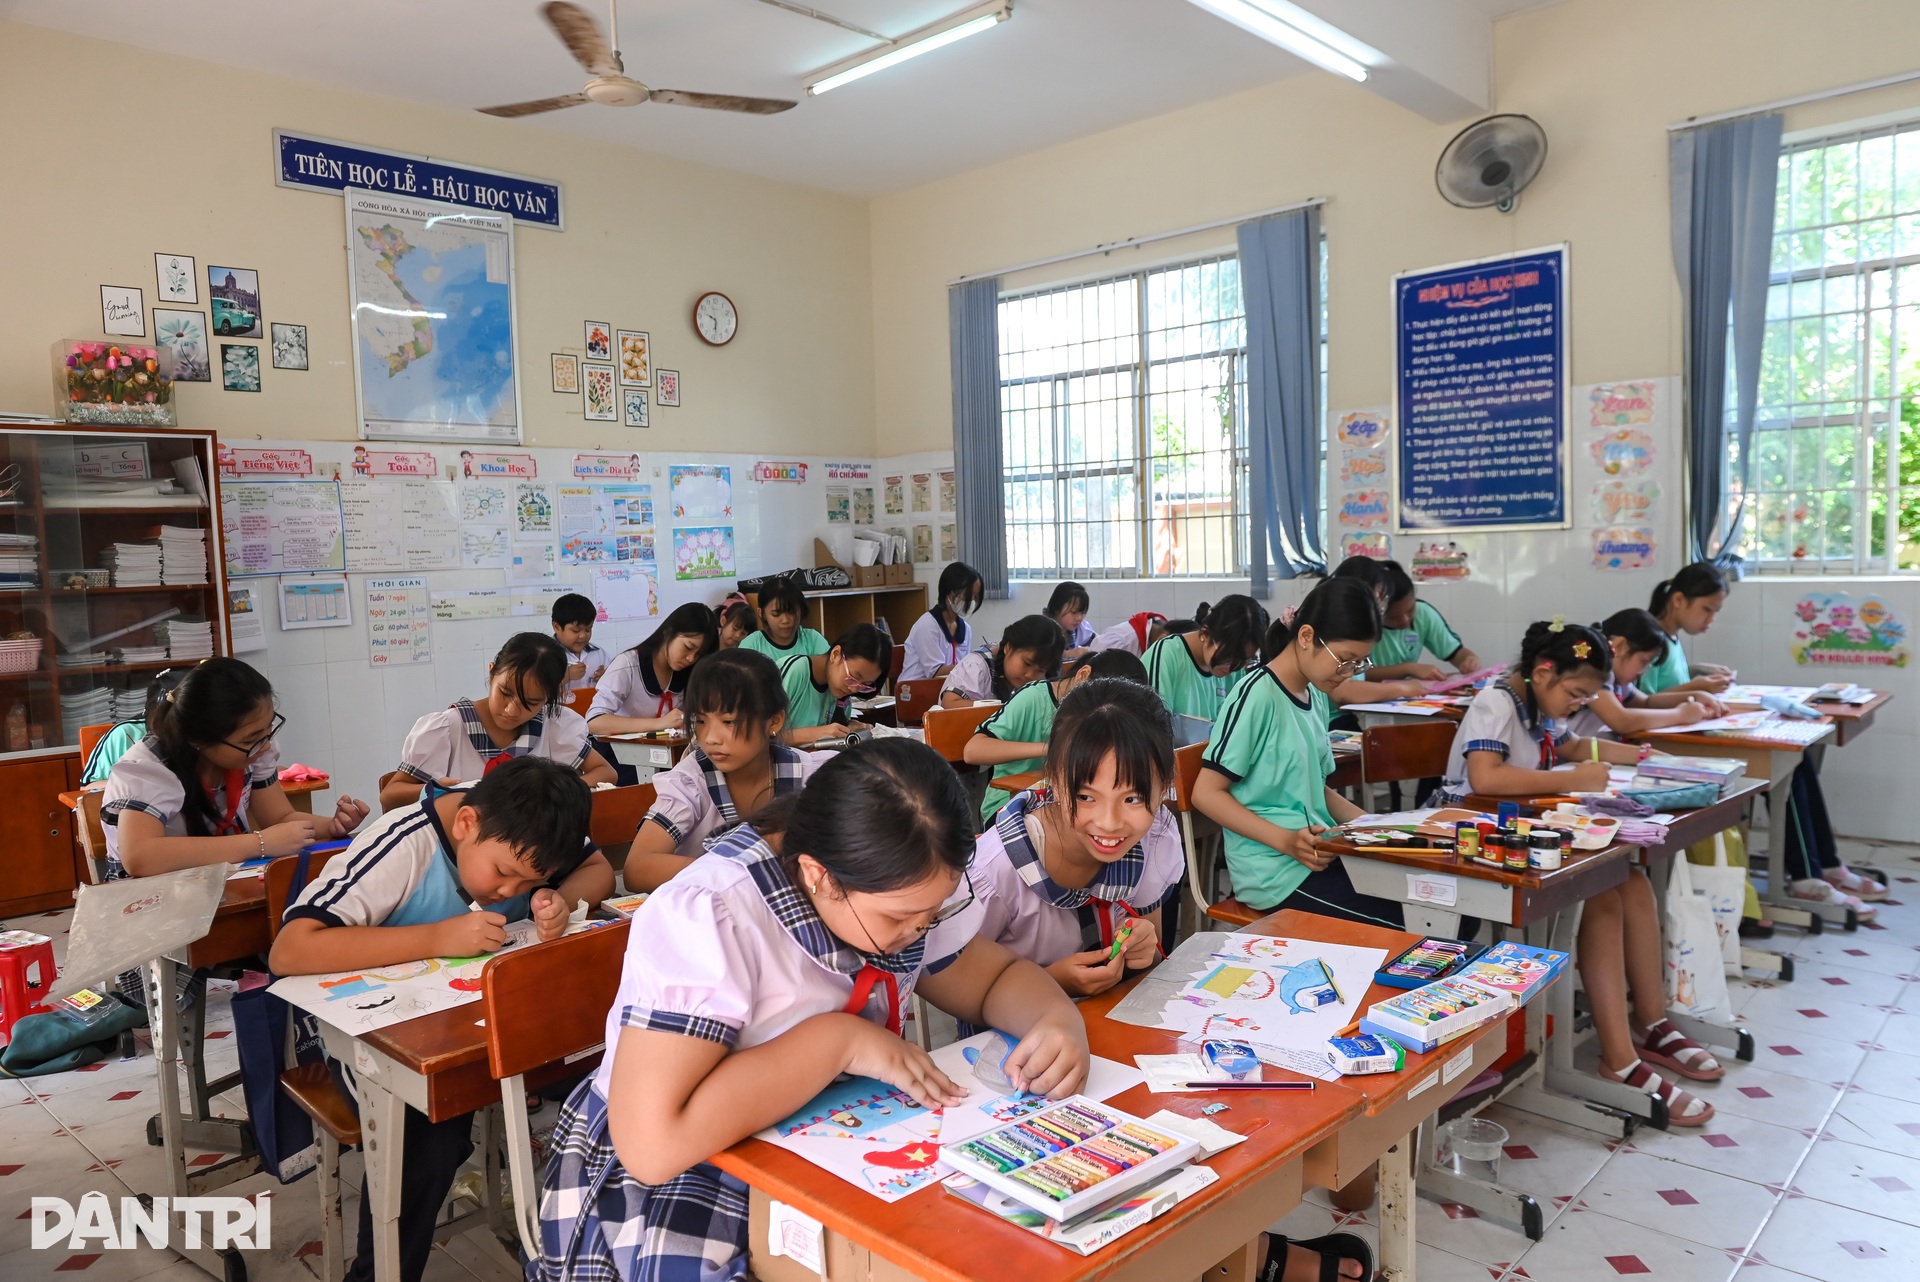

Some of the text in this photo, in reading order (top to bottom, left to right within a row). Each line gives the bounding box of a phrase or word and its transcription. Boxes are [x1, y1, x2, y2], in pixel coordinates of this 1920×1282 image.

[348, 163, 388, 189] HỌC
[393, 164, 416, 192] LỄ
[432, 176, 469, 203] HẬU
[474, 186, 509, 209] HỌC
[514, 190, 547, 214] VĂN
[358, 201, 379, 209] CỘNG
[1467, 276, 1488, 295] CỦA
[105, 297, 130, 320] Good
[242, 459, 300, 471] Tiếng Việt
[388, 463, 418, 472] Toán
[481, 464, 526, 475] Khoa Học
[370, 609, 386, 617] Ngày
[1196, 1174, 1209, 1185] 36
[1112, 1223, 1124, 1234] Oil
[1125, 1209, 1149, 1229] Pastels
